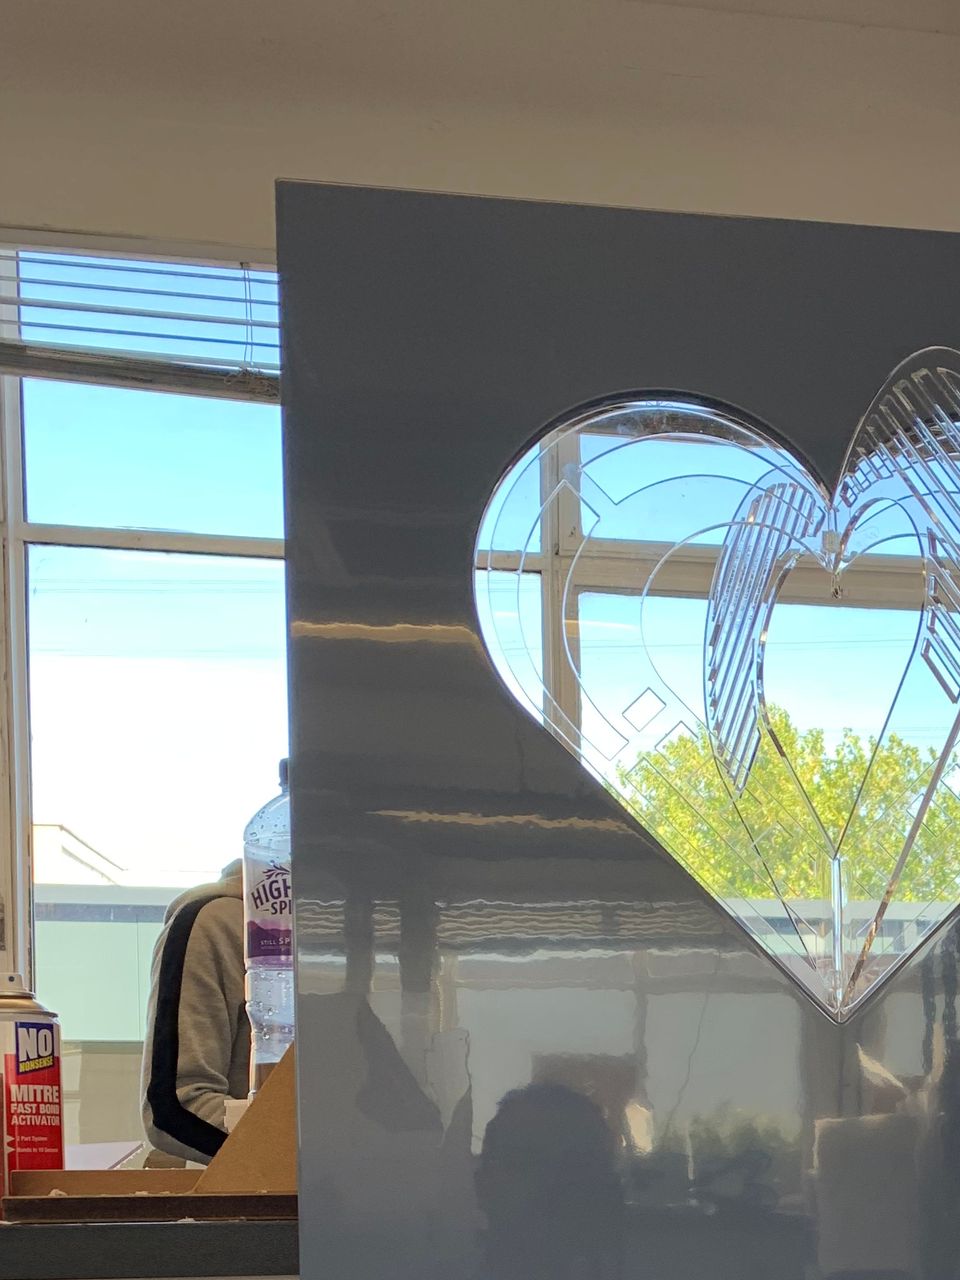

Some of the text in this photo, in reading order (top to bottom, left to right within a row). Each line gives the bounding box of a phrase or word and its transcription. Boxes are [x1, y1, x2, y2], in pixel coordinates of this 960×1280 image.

[18, 1027, 52, 1061] NO
[19, 1056, 53, 1072] NONSENSE
[10, 1084, 59, 1102] MITRE
[10, 1103, 60, 1114] FAST BOND
[11, 1115, 60, 1126] ACTIVATOR
